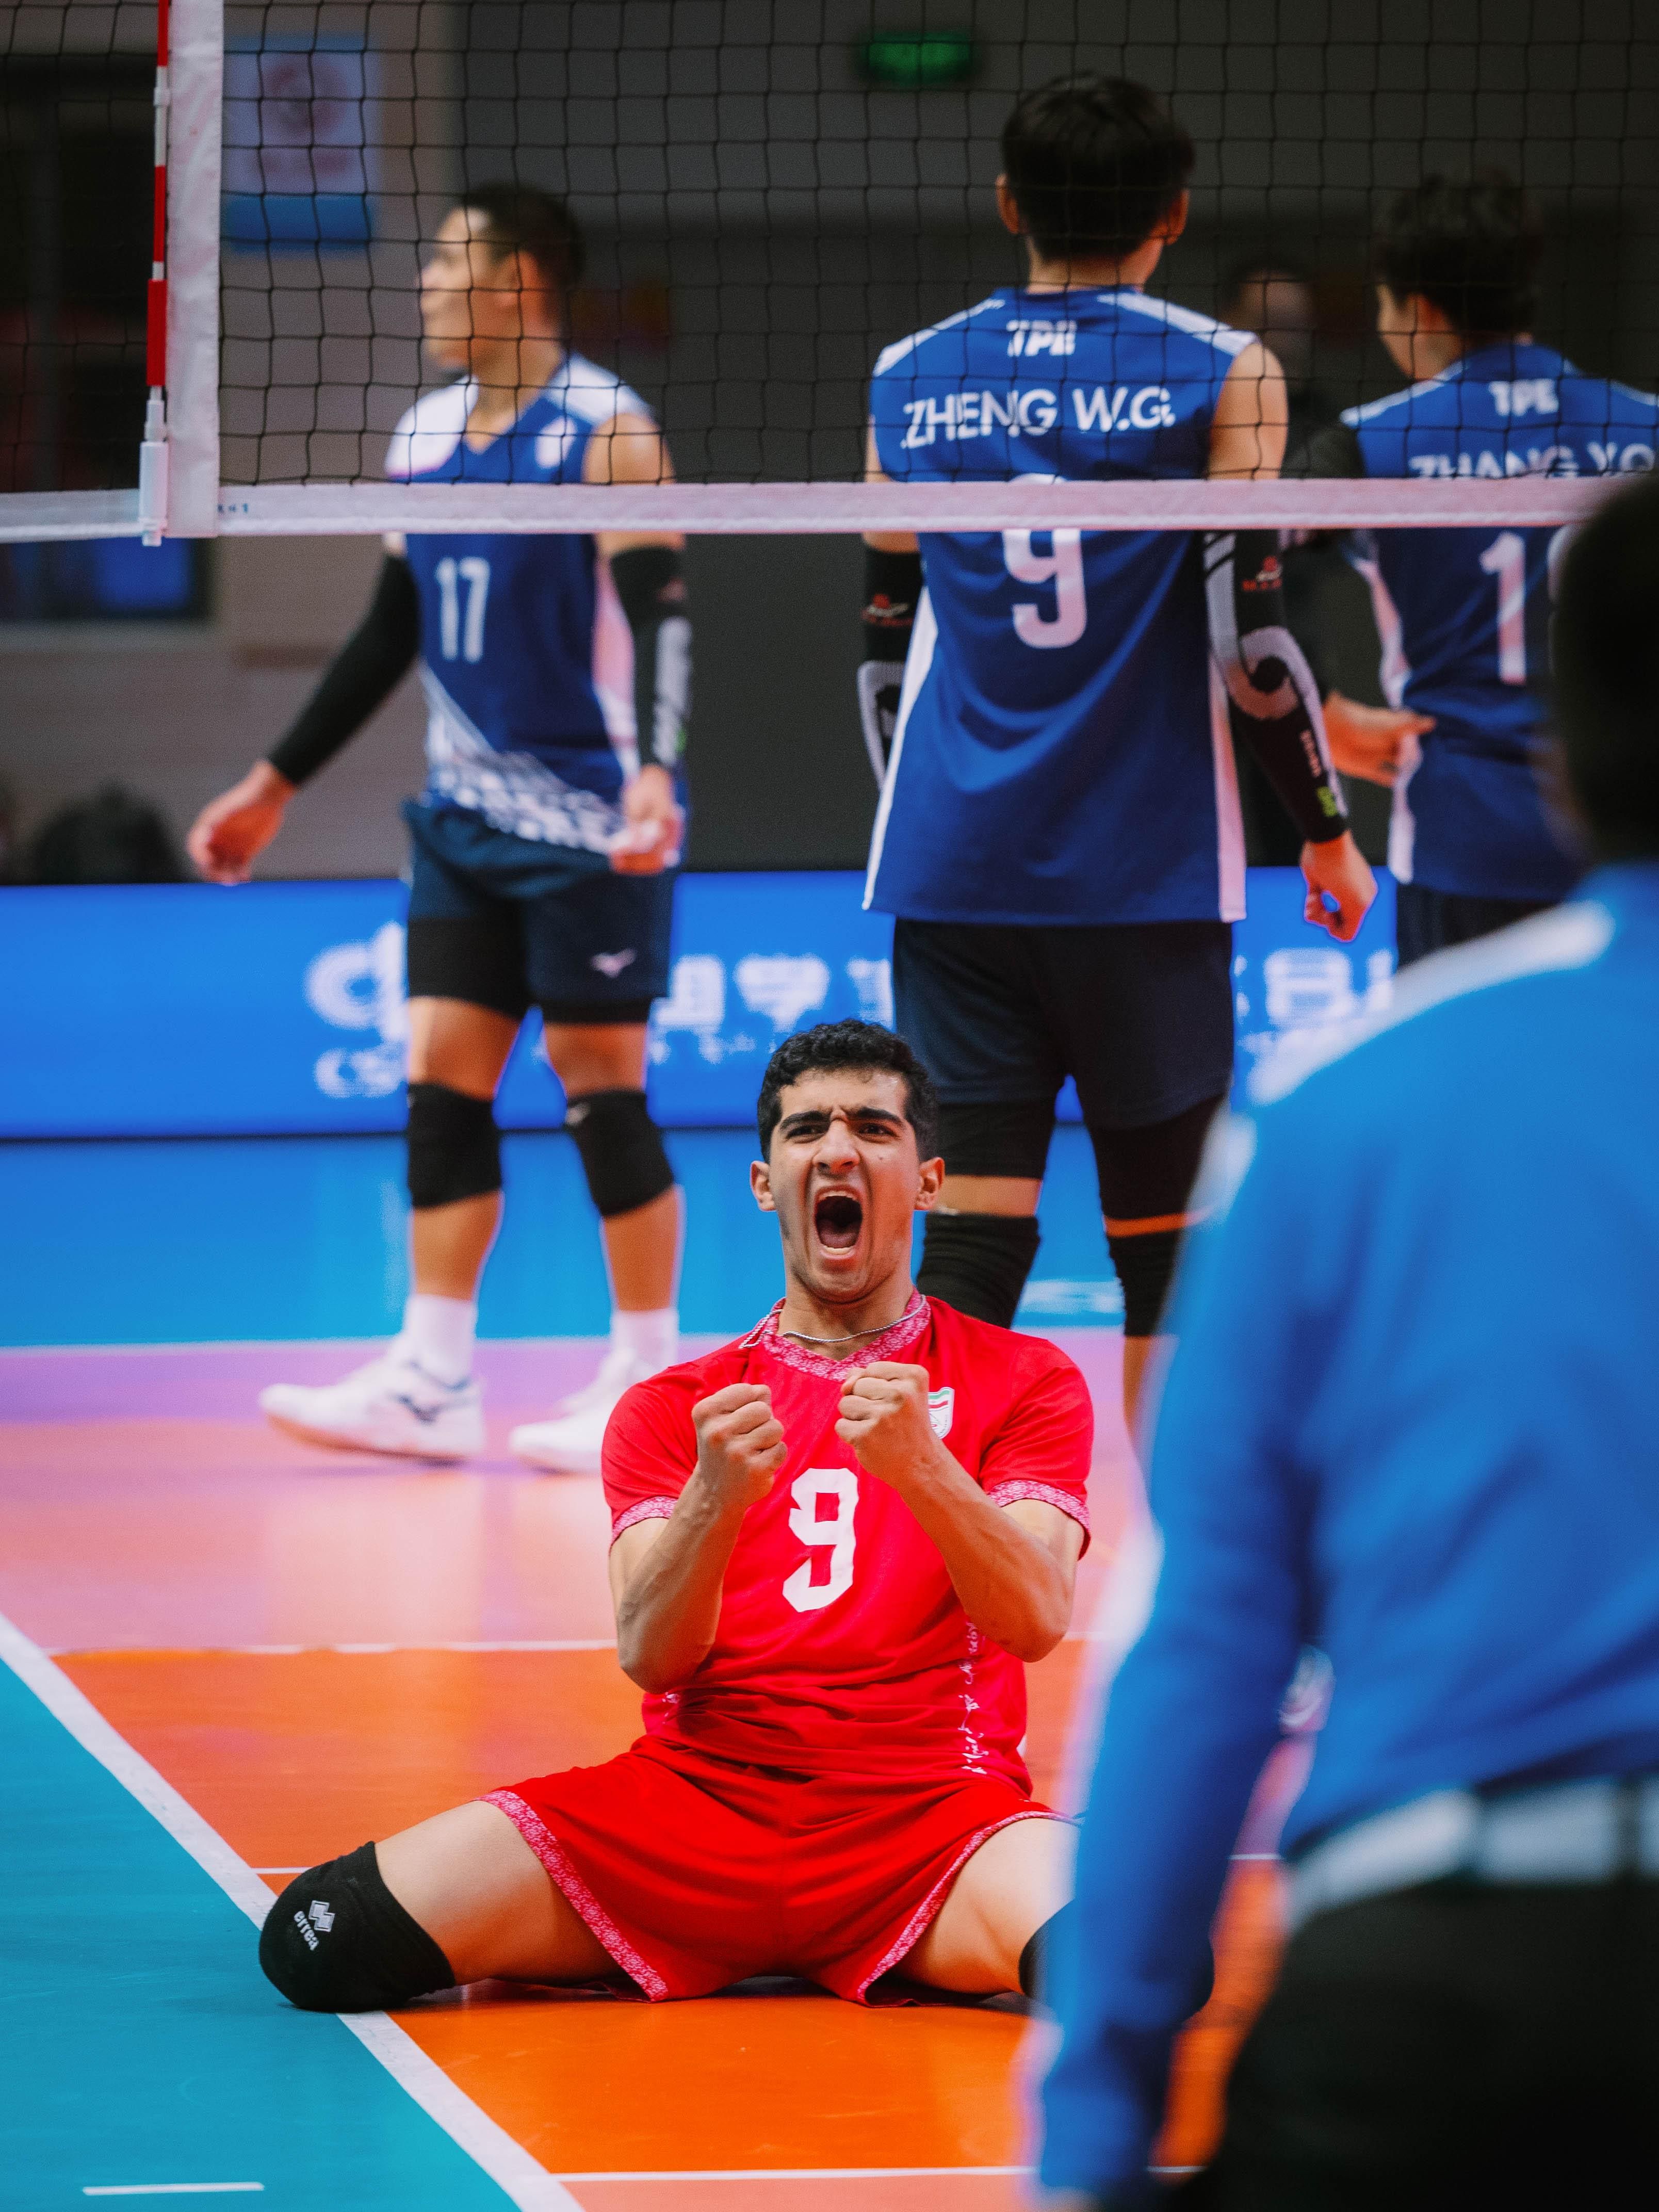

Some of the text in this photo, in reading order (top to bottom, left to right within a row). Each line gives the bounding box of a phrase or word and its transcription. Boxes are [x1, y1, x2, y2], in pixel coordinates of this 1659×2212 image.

[900, 388, 1058, 449] ZHENG
[435, 557, 491, 663] 17
[1003, 474, 1087, 648] 9
[782, 1468, 859, 1613] 9
